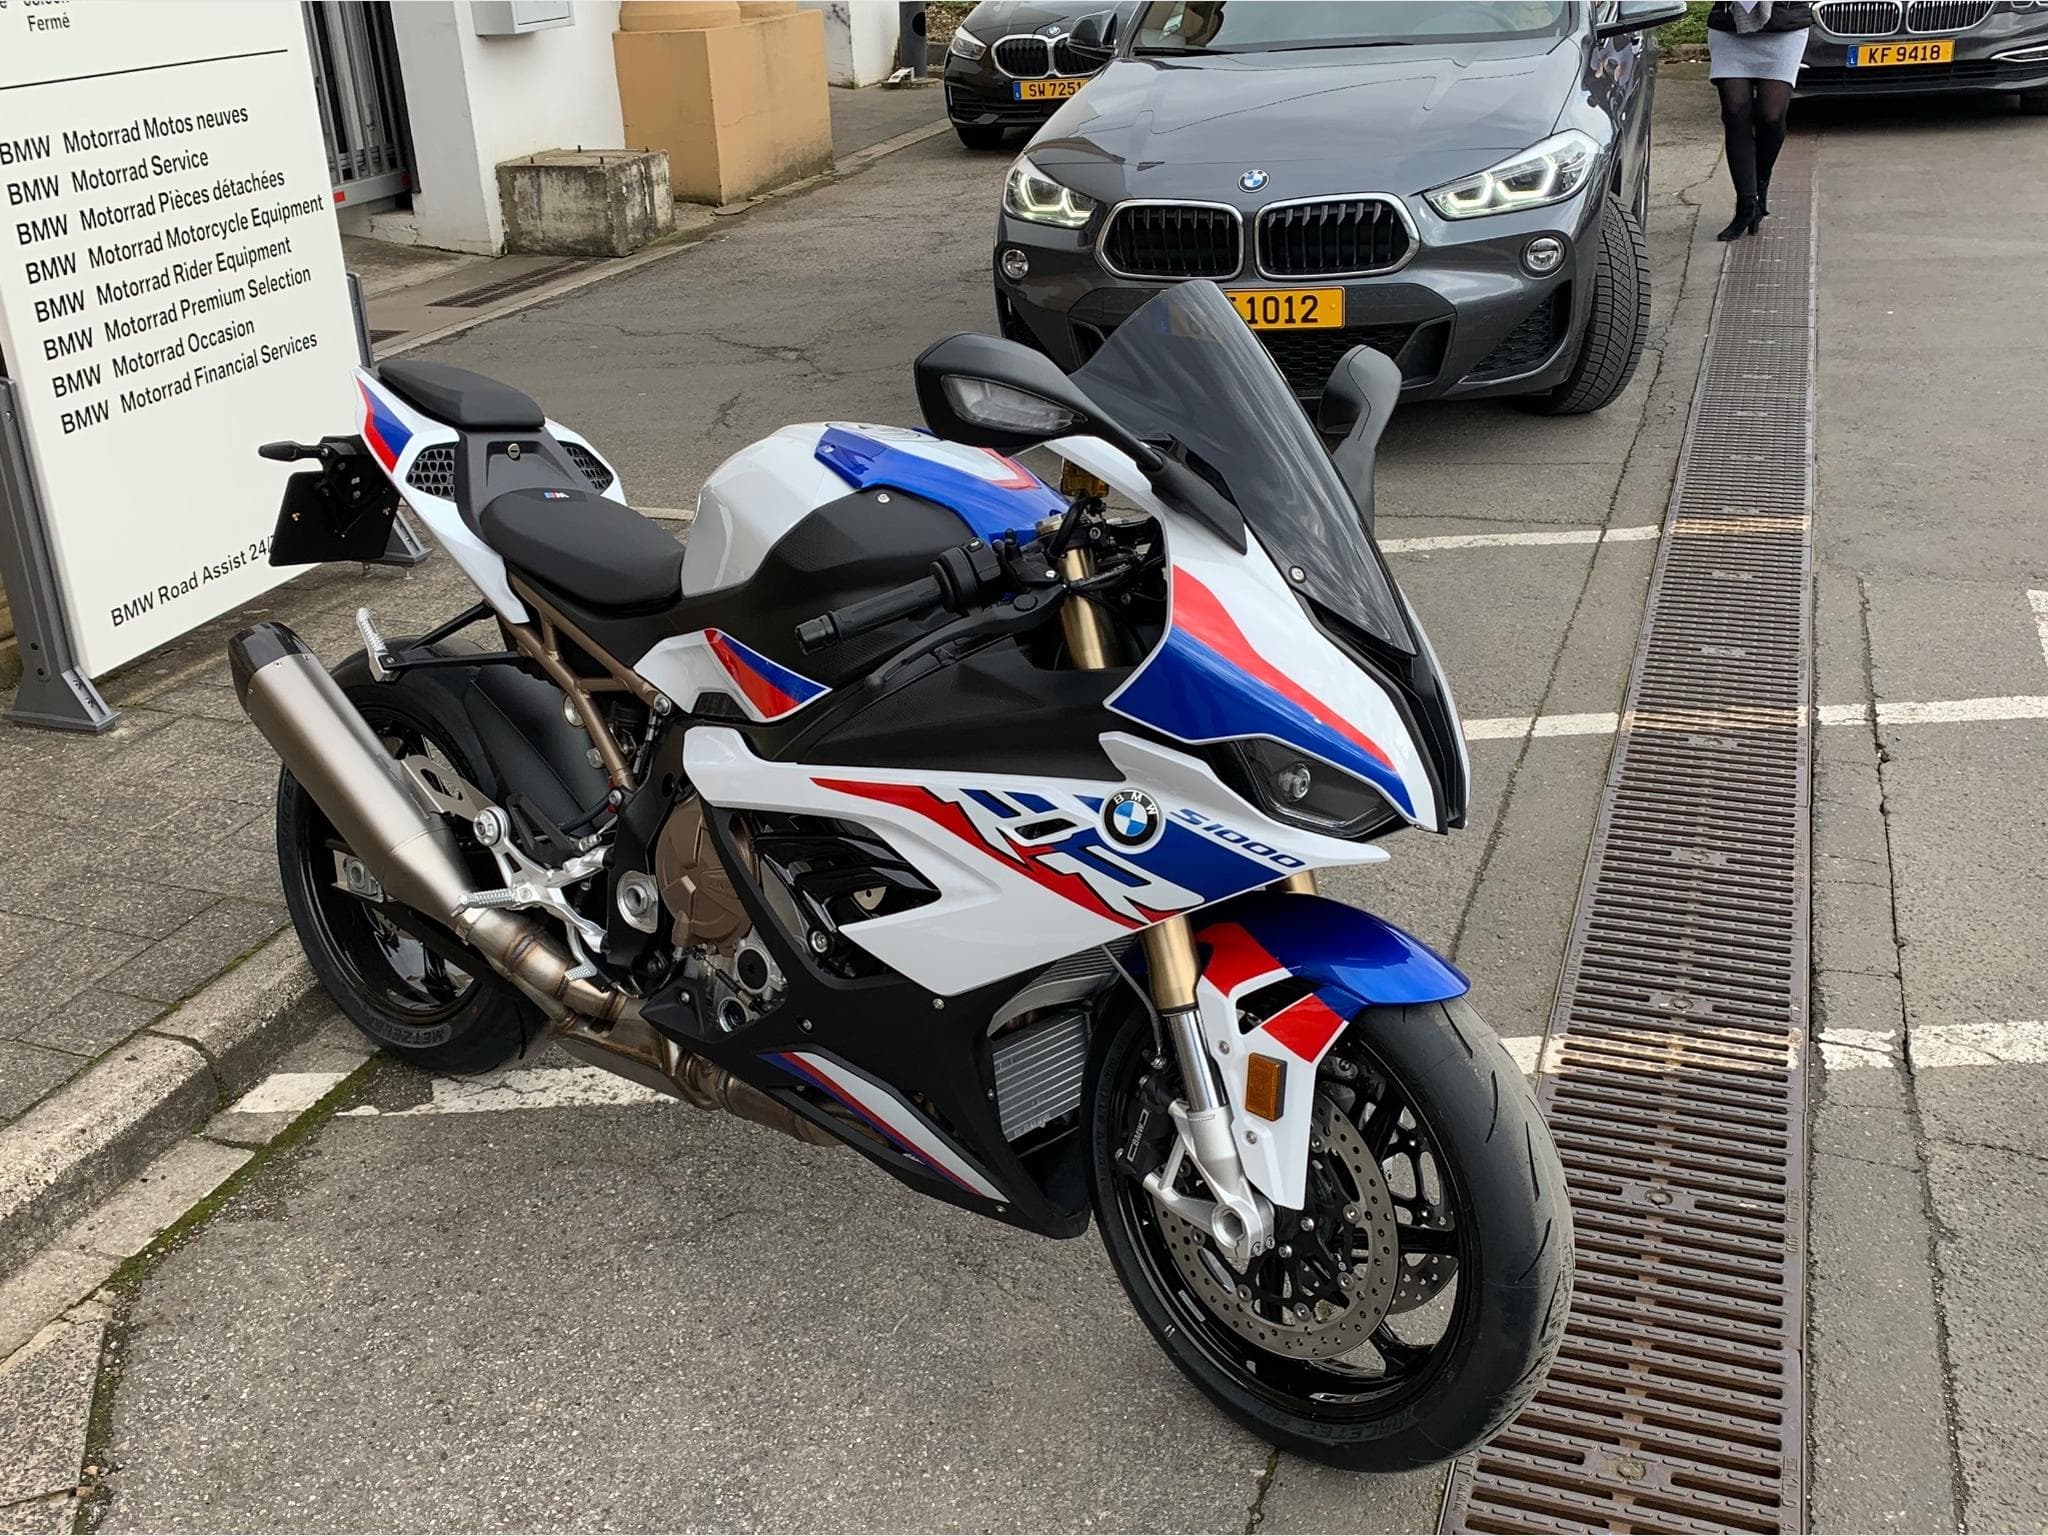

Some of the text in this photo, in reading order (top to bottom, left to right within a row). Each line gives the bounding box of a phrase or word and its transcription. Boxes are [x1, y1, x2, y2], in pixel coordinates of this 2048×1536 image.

[26, 11, 71, 32] Fermé
[1868, 44, 1941, 64] KF 9418
[1028, 83, 1046, 98] SW
[0, 108, 248, 165] BMW Motorrad Motos neuves
[7, 150, 208, 205] BMW Motorrad Service
[16, 170, 284, 245] BMW Motorrad Pièces détachées
[26, 195, 324, 284] BMW Motorrad Motorcycle Equipment
[34, 237, 291, 322] BMW Motorrad Rider Equipment
[1246, 295, 1319, 325] 1012
[43, 268, 311, 360] BMW Motorrad Premium Selection
[52, 321, 255, 398] BMW Motorrad Occasion
[61, 334, 317, 434] BMW Motorrad Financial Services
[111, 535, 274, 627] BMW Road Assist 24/
[1113, 791, 1158, 816] BMW
[1168, 807, 1306, 869] S1000
